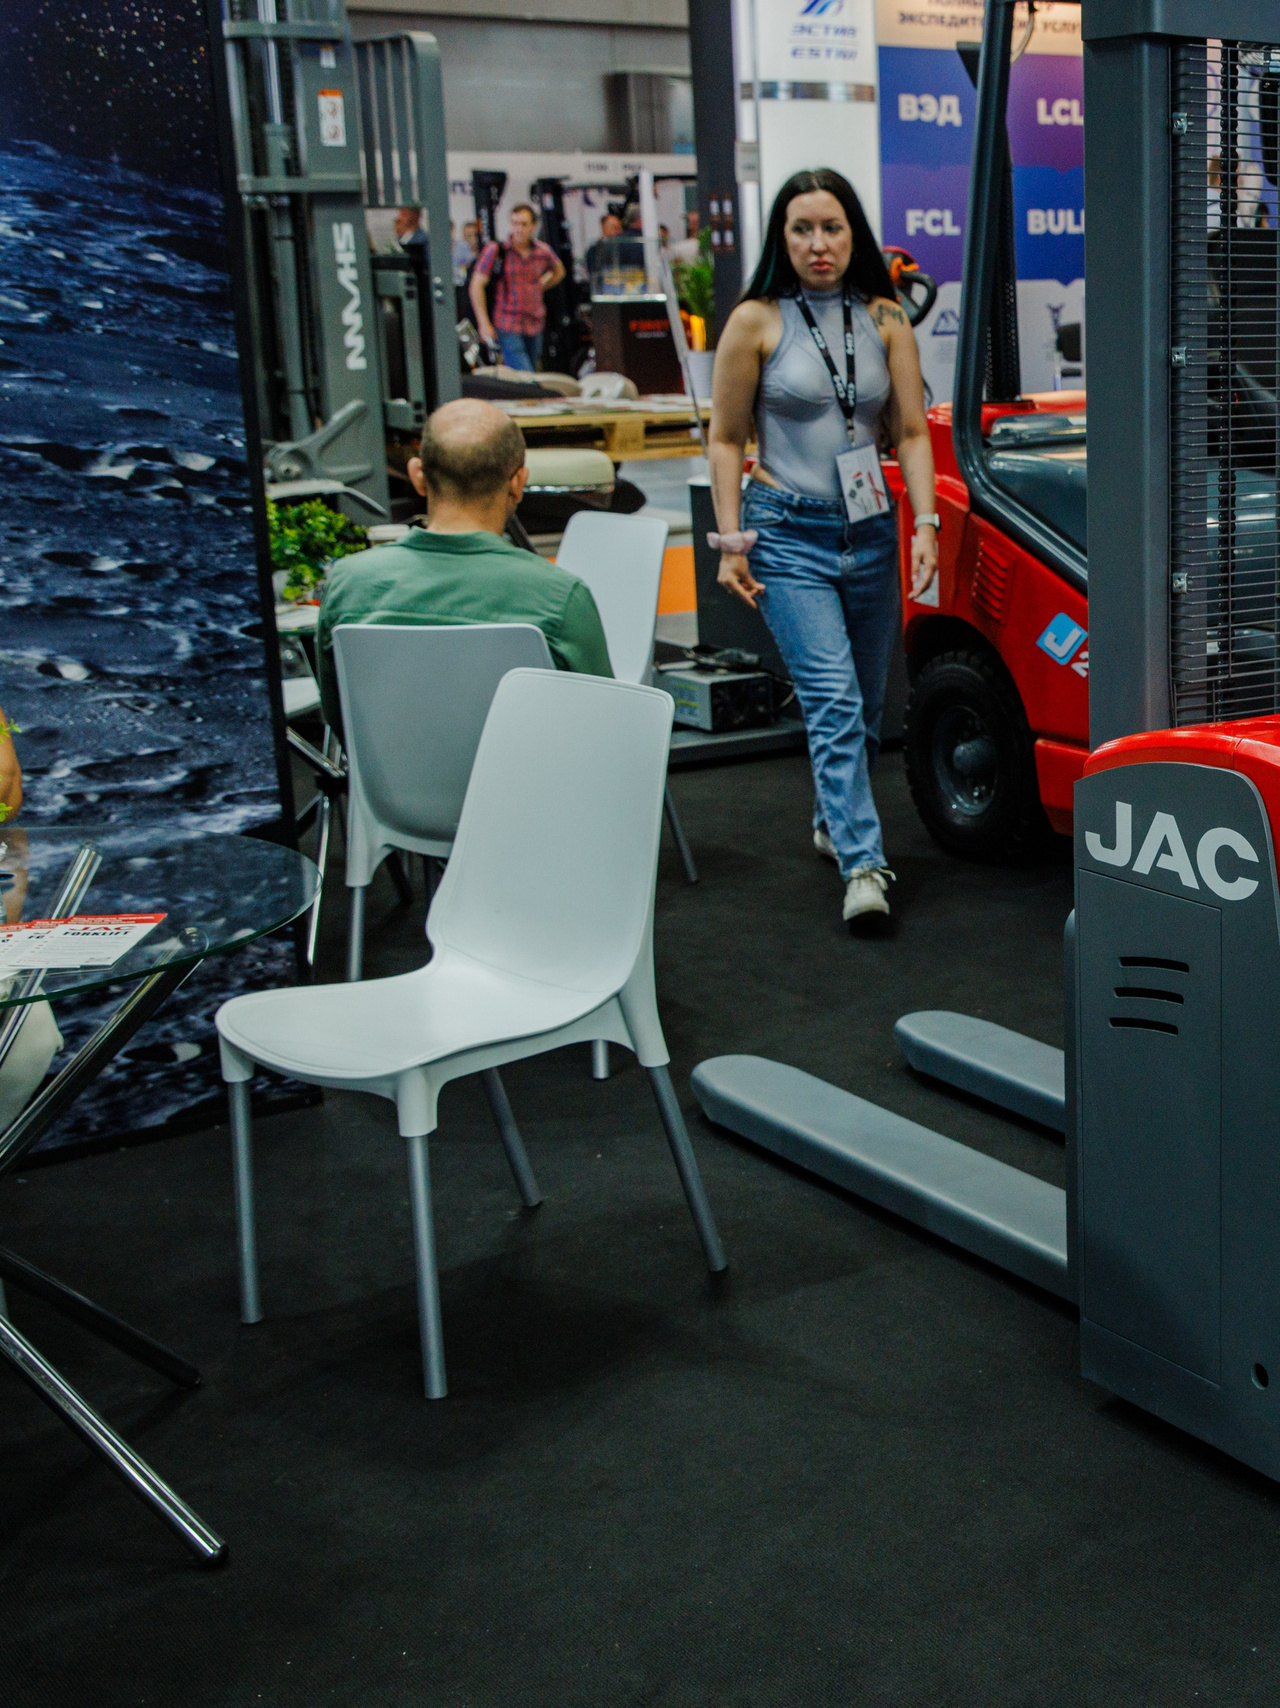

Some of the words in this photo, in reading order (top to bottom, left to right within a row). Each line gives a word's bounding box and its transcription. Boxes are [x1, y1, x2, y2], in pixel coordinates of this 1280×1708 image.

[898, 94, 962, 127] ВЭД
[1036, 97, 1084, 126] LCL
[905, 208, 962, 236] FCL
[1084, 800, 1260, 901] JAC
